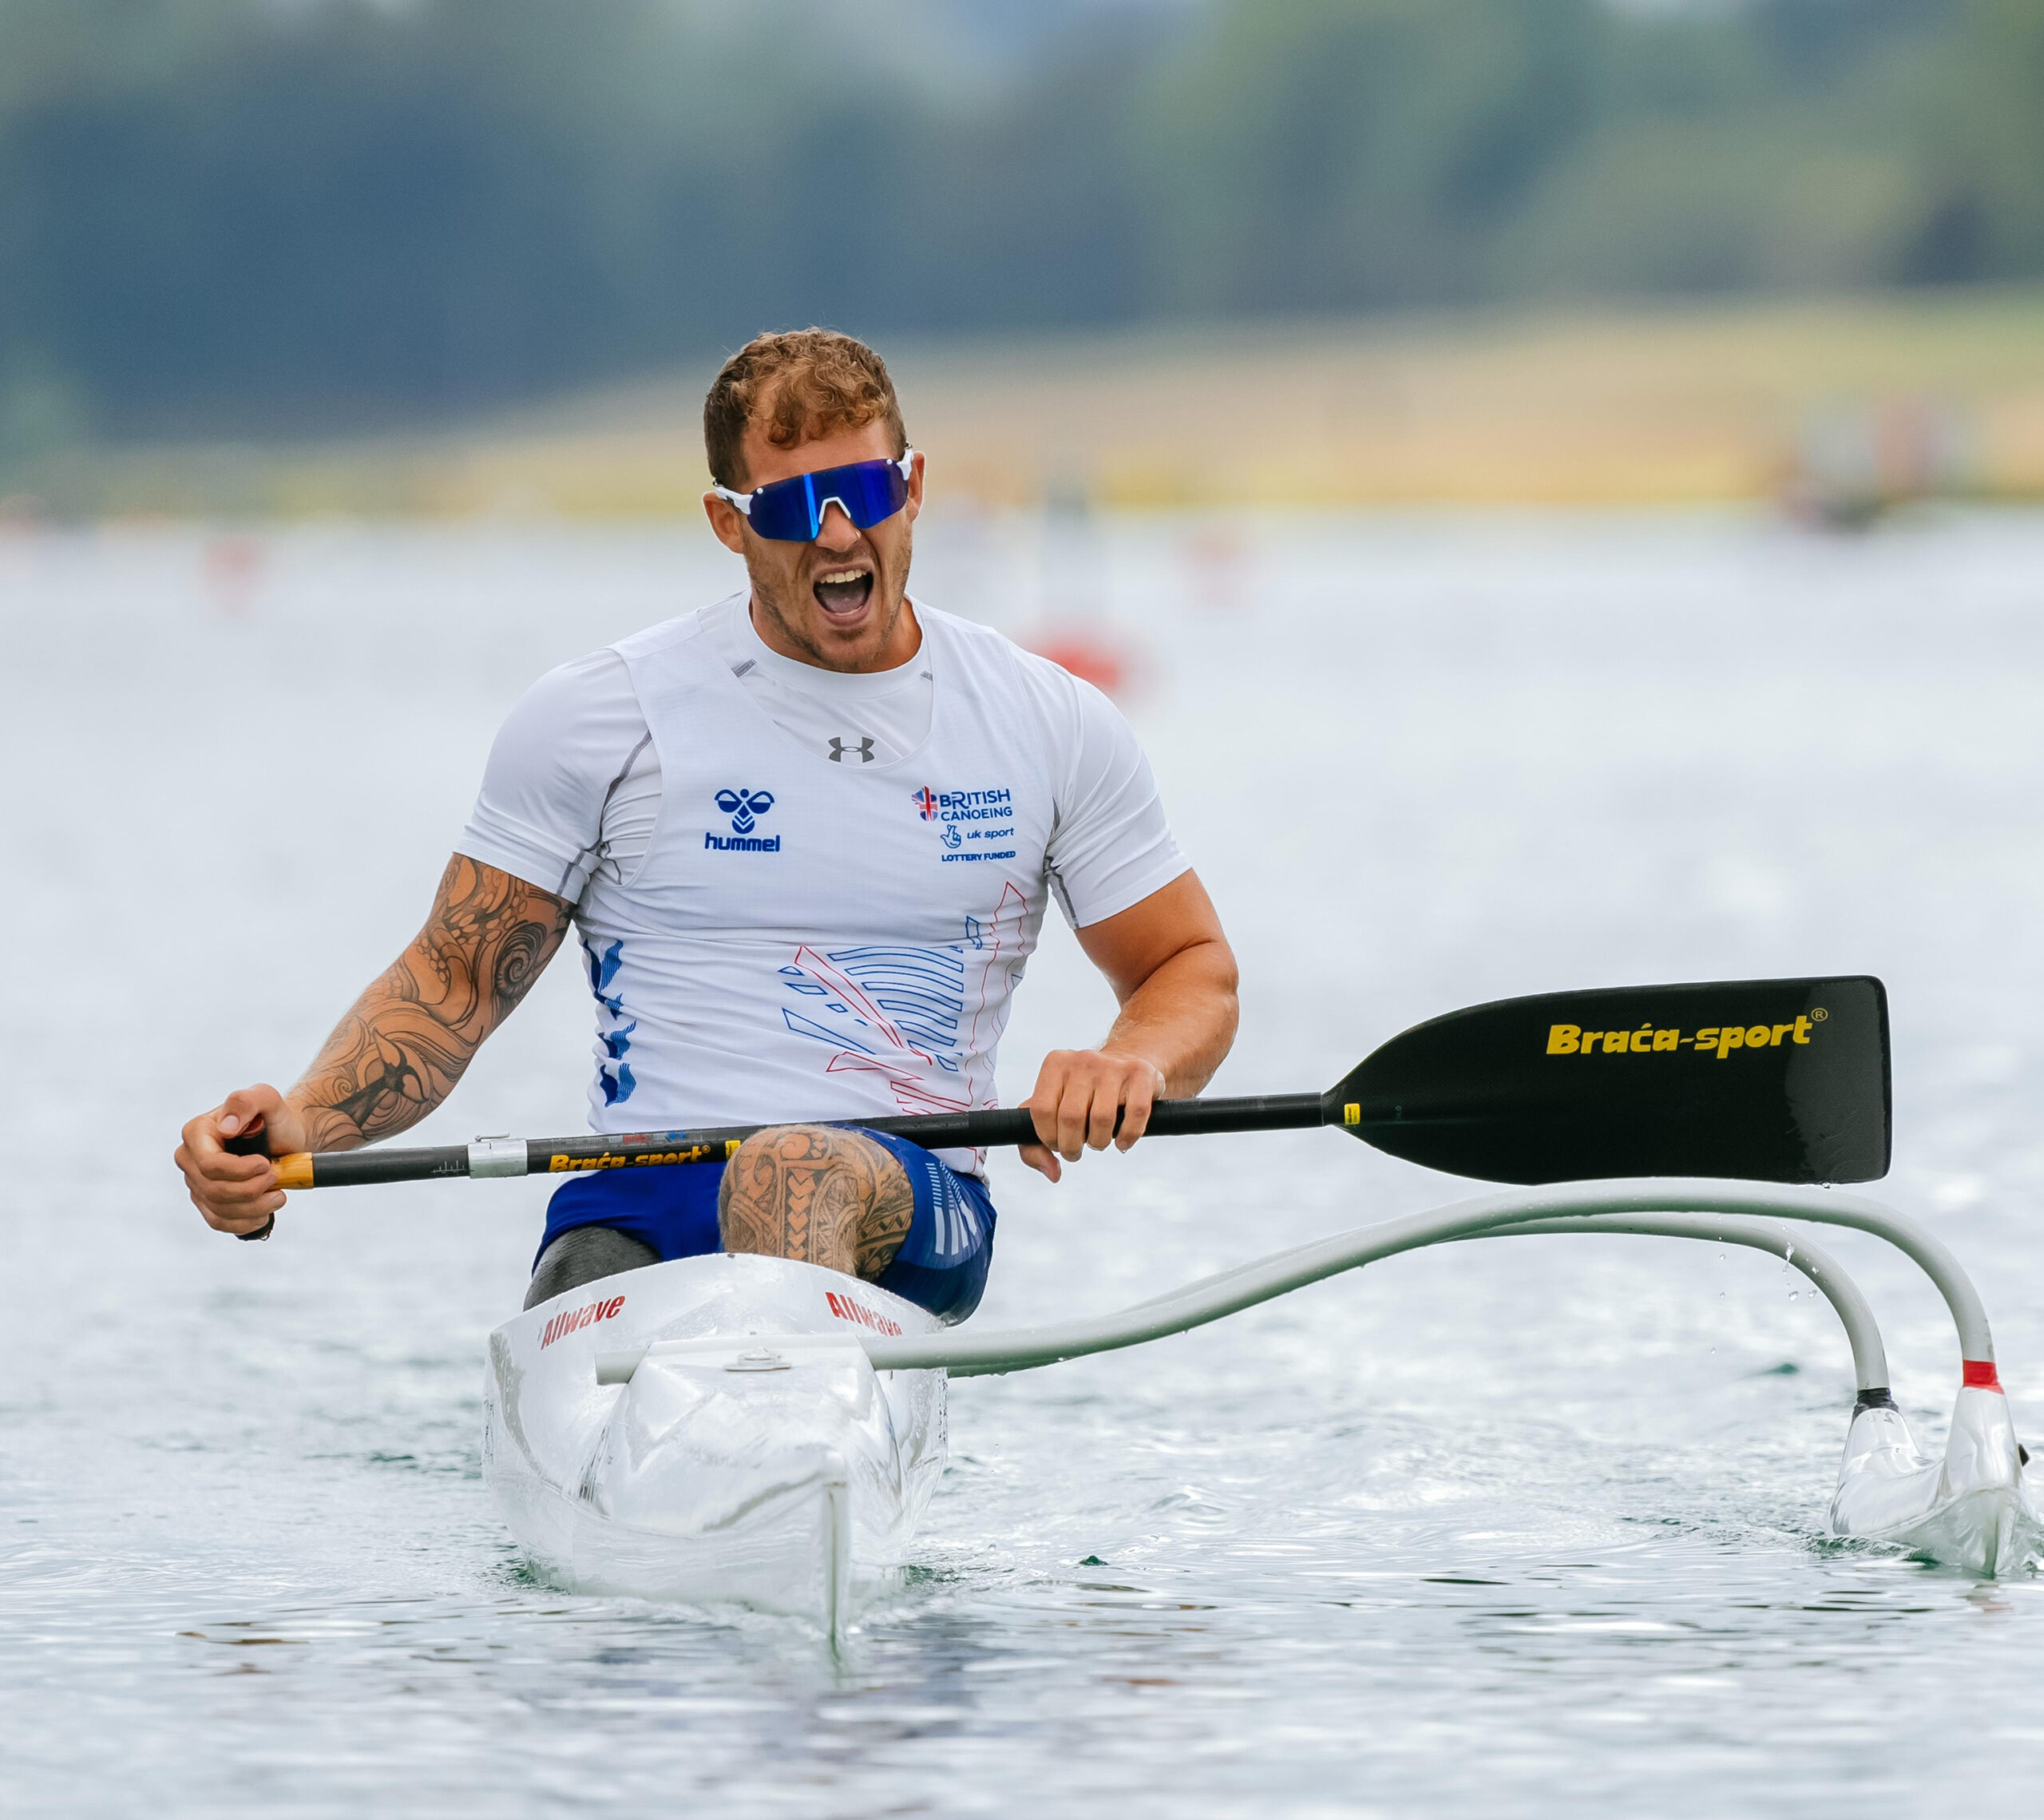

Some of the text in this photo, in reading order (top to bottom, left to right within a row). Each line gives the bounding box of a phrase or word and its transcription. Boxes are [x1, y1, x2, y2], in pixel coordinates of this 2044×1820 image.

[939, 788, 1011, 810] BRITISH
[941, 806, 1013, 822] CANOEING
[704, 831, 781, 852] hummel
[967, 827, 1015, 839] uk sport
[941, 851, 1016, 862] LOTTERY FUNDED
[541, 1295, 626, 1350] Allwave
